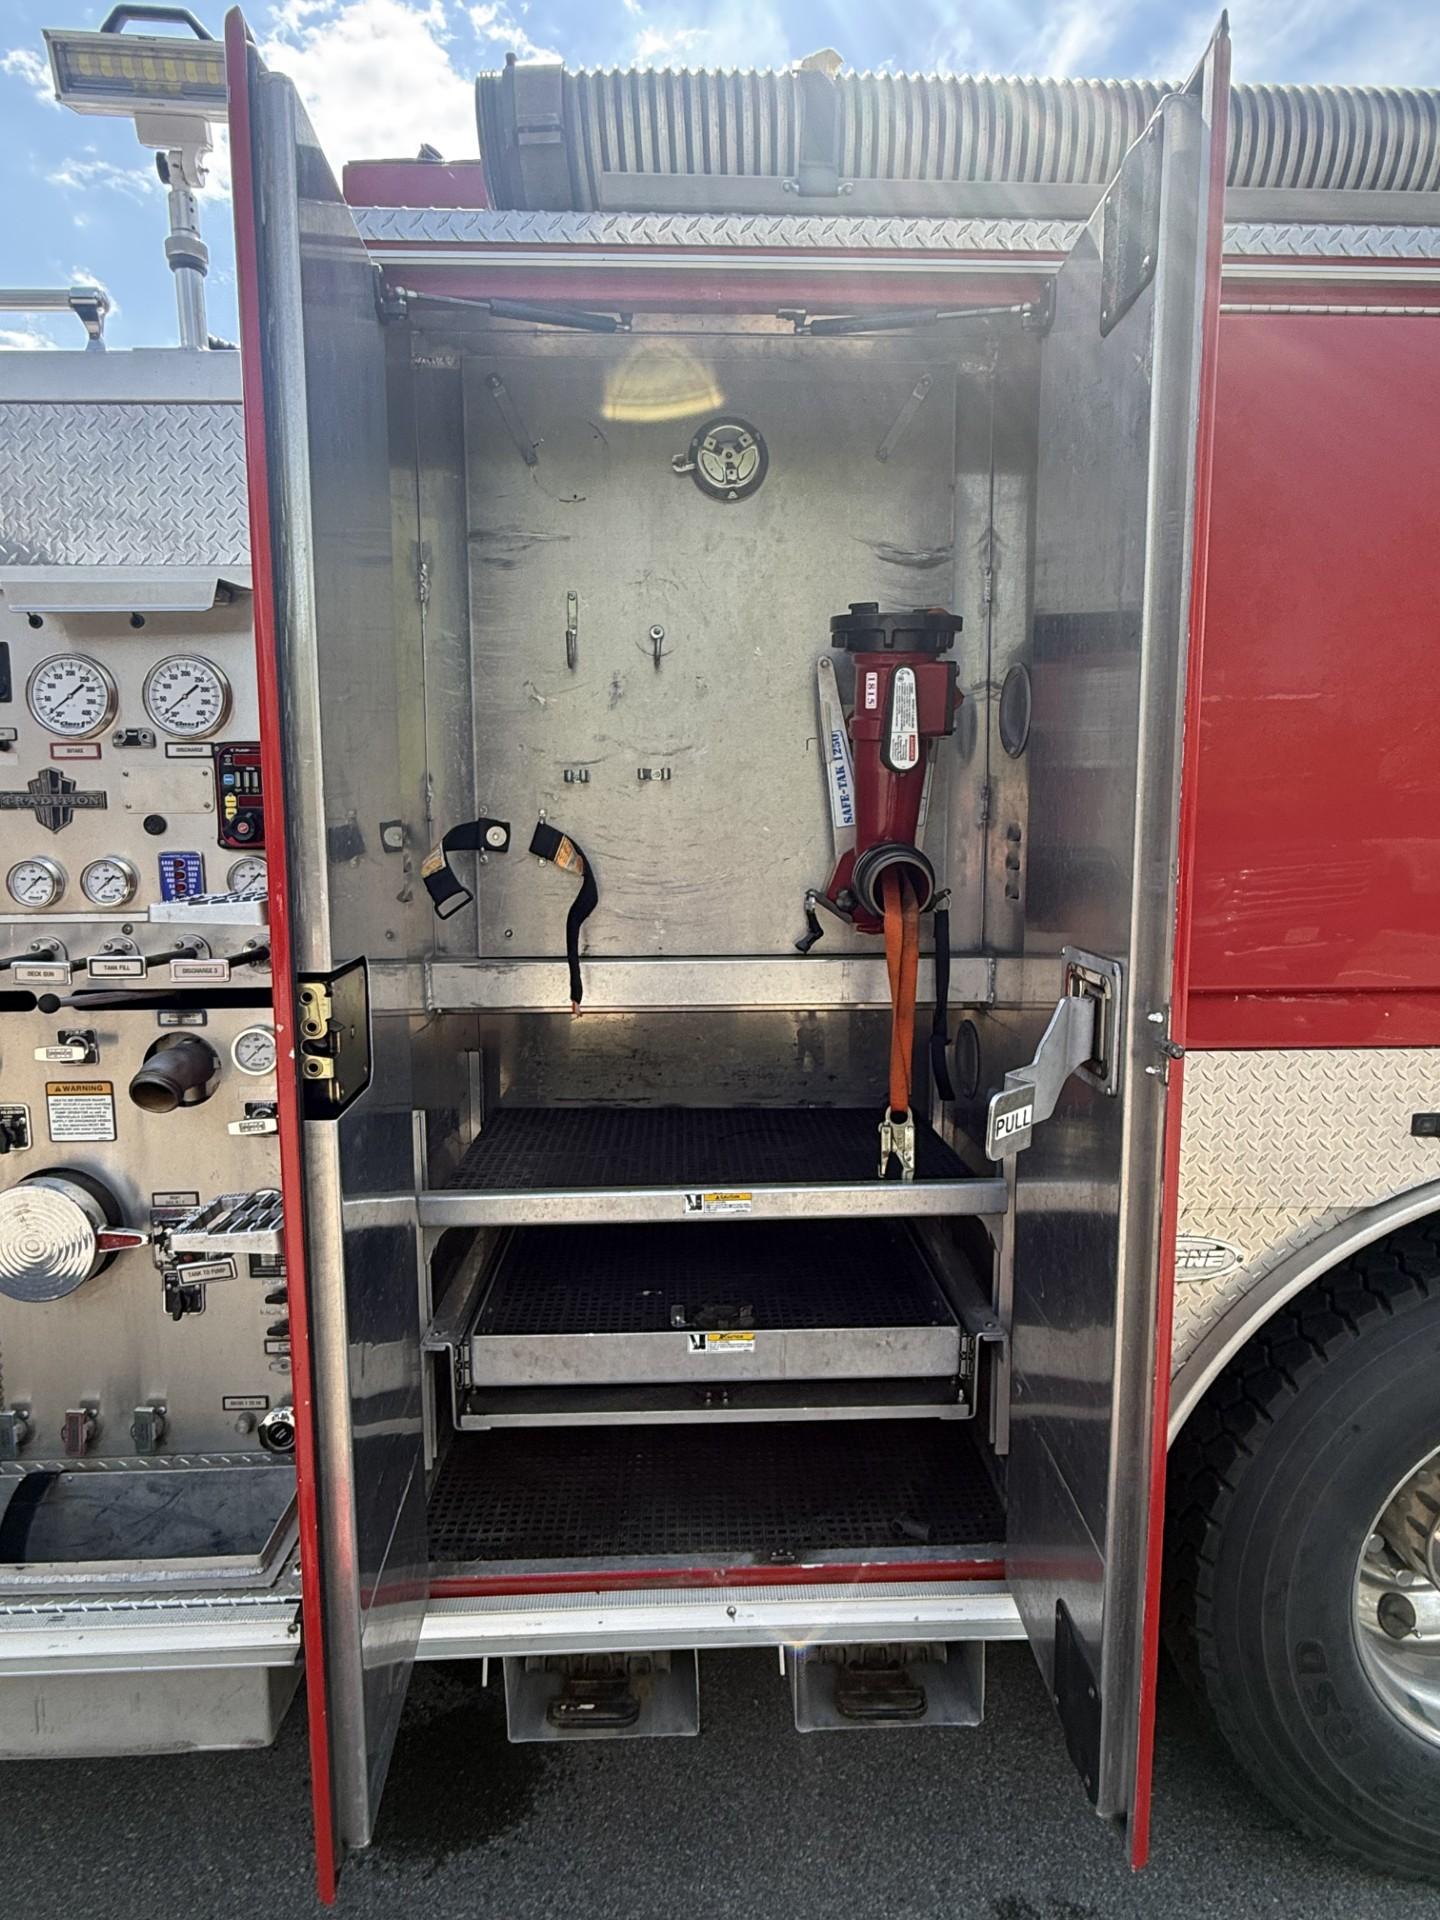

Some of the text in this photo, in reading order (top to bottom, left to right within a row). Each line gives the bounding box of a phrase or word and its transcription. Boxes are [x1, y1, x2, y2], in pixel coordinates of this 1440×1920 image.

[831, 734, 853, 824] SAFE-TAK 1250
[63, 1084, 103, 1092] WARNING
[996, 1110, 1030, 1137] PULL
